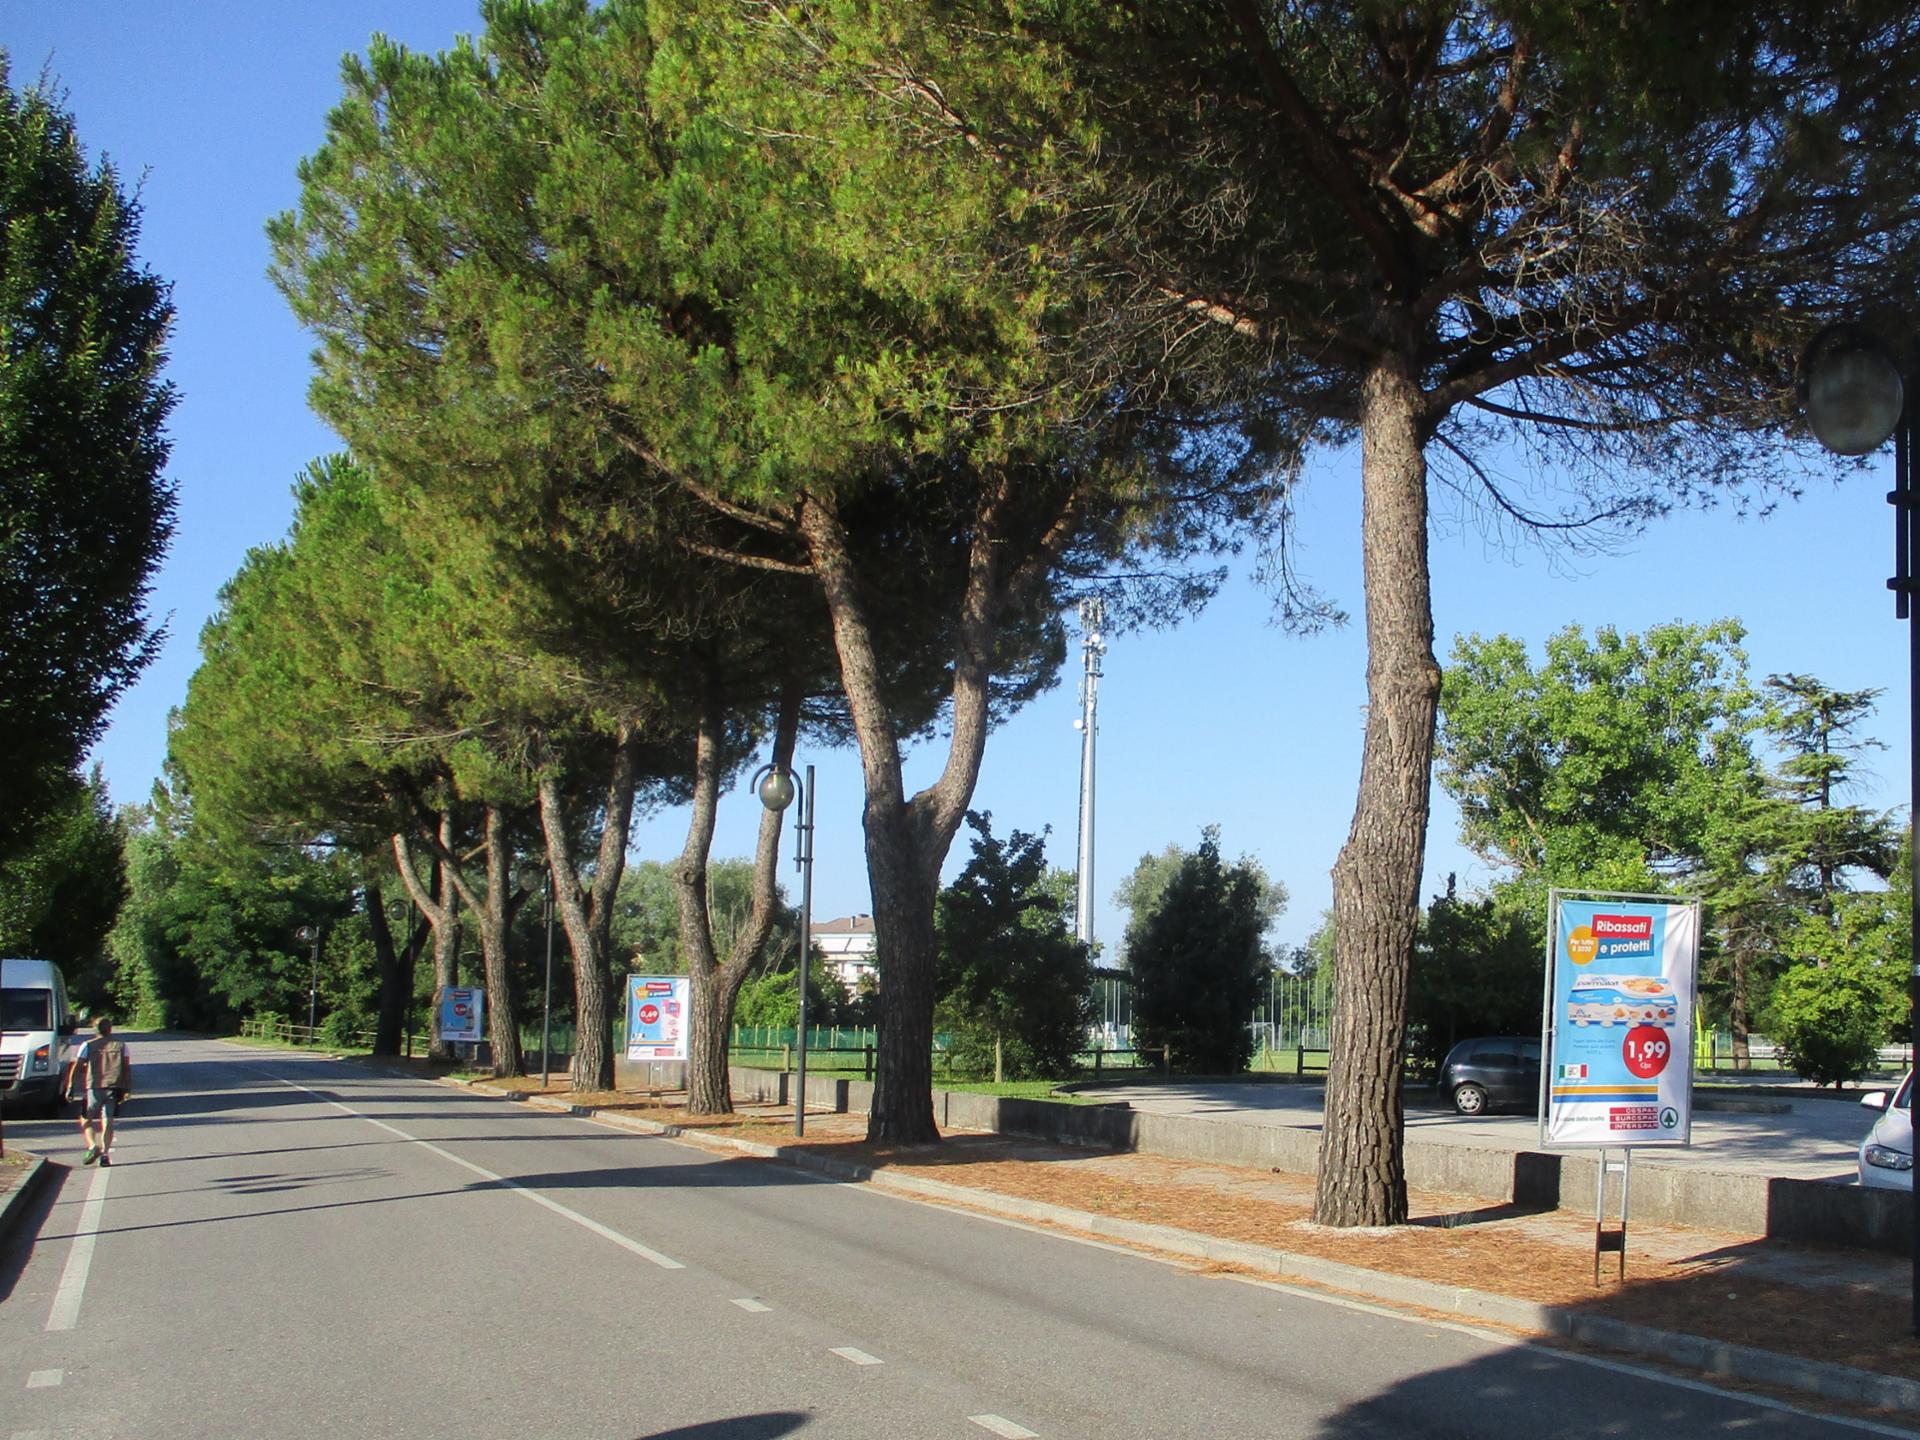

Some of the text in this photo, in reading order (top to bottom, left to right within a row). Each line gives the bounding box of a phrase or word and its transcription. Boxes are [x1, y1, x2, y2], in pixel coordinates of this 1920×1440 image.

[1596, 921, 1647, 933] Ribassati
[1600, 940, 1650, 955] e protetti
[1628, 1041, 1667, 1062] 1,99
